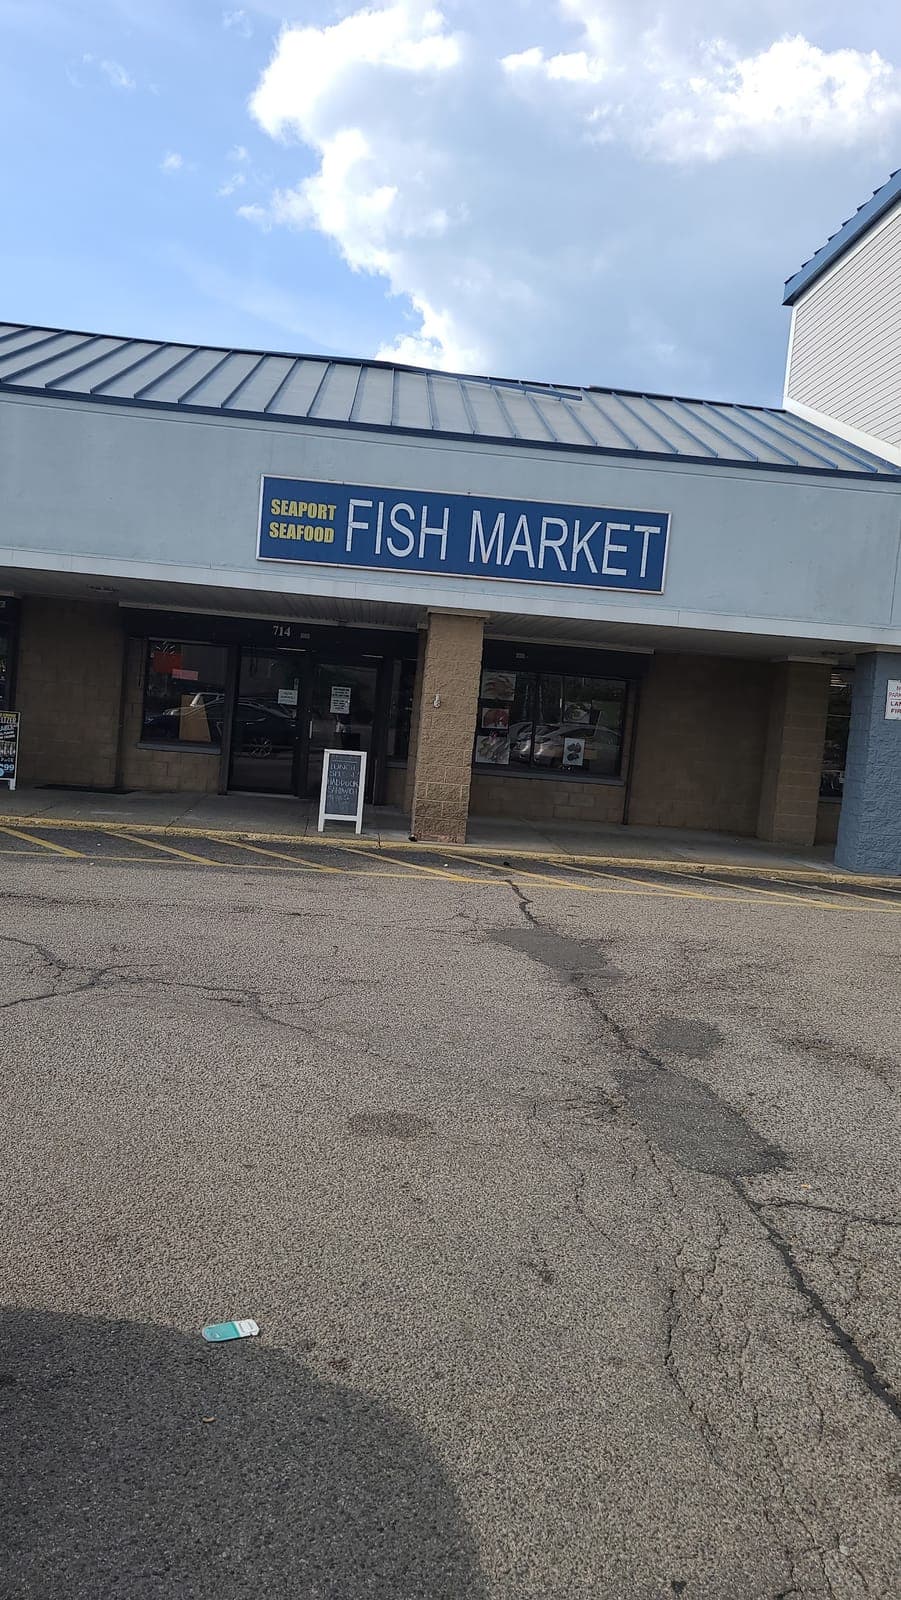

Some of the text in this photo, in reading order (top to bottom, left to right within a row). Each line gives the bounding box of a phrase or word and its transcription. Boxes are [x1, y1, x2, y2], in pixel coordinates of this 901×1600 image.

[270, 499, 336, 521] SEAPORT
[268, 522, 335, 544] SEAFOOD
[345, 498, 662, 578] FISH MARKET
[273, 625, 291, 637] 714
